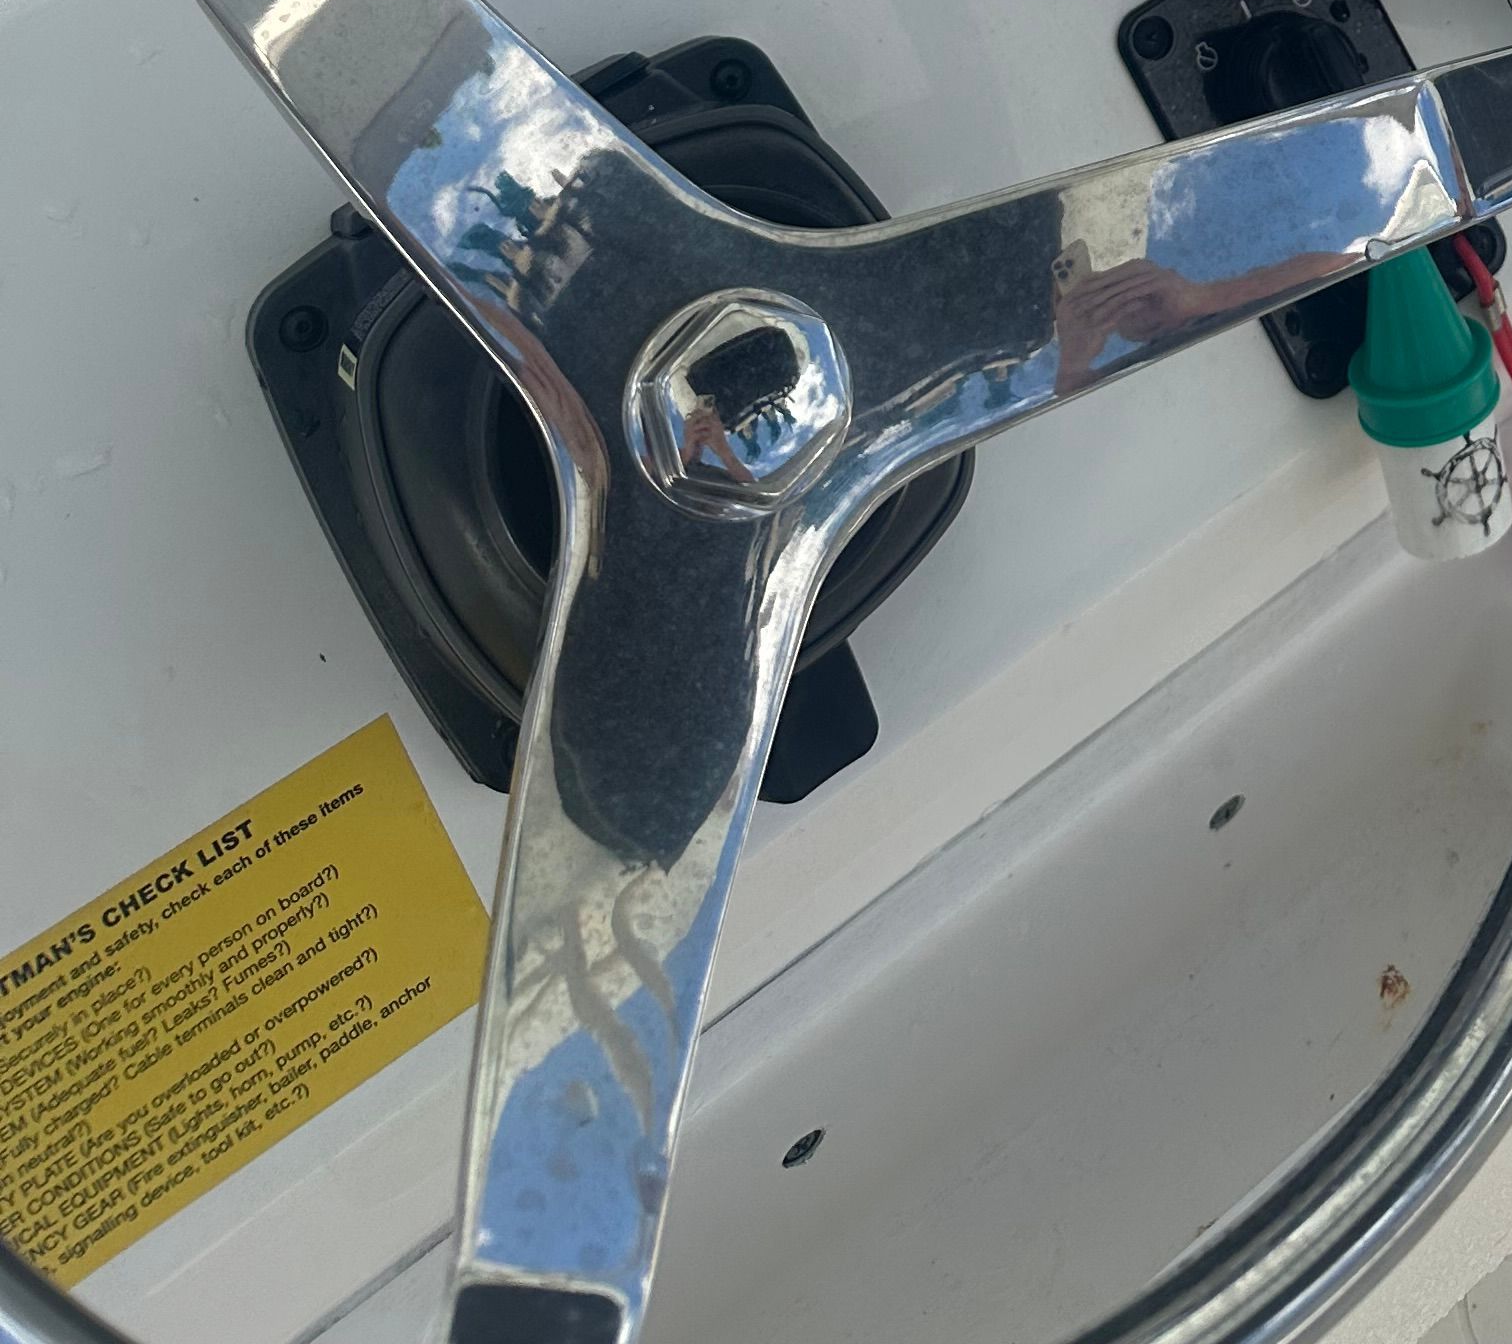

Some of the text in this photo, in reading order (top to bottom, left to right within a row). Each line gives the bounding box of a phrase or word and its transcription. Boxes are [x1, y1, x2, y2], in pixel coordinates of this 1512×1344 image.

[70, 951, 102, 980] and
[105, 919, 159, 956] safety,
[162, 883, 211, 919] check
[214, 856, 252, 885] each
[256, 839, 271, 858] of
[273, 814, 317, 845] these
[319, 784, 363, 817] items
[102, 860, 194, 927] CHECK
[197, 819, 252, 867] LIST
[0, 865, 338, 1096] DEVICES (One for every person on board?)
[11, 1004, 52, 1040] your
[57, 961, 121, 1008] engine:
[19, 1150, 78, 1197] PLATE
[80, 1129, 115, 1158] (Are
[116, 1104, 149, 1135] you
[152, 1039, 241, 1108] overloaded
[244, 1027, 259, 1045] or
[265, 947, 377, 1031] overpowered?)
[31, 1059, 117, 1123] (Adequate
[118, 1027, 157, 1062] fuel?
[161, 986, 218, 1033] Leaks?
[222, 940, 290, 992] Fumes?)
[44, 1075, 119, 1135] charged?
[123, 1044, 173, 1080] Cable
[175, 993, 248, 1046] terminals
[252, 963, 294, 995] clean
[297, 938, 326, 965] and
[328, 904, 377, 942] tight?)
[66, 1021, 139, 1076] (Working
[142, 970, 213, 1024] smoothly
[219, 945, 249, 973] and
[251, 892, 329, 954] properly?)
[70, 1010, 89, 1025] in
[91, 966, 151, 1016] place?)
[17, 1120, 91, 1177] neutral?)
[27, 1130, 142, 1215] CONDITIONS
[143, 1102, 187, 1138] (Safe
[188, 1088, 207, 1105] to
[210, 1072, 232, 1094] go
[235, 1039, 275, 1073] out?)
[58, 1135, 163, 1217] EQUIPMENT
[168, 1099, 229, 1144] (Lights,
[229, 1069, 273, 1100] horn,
[276, 1032, 326, 1071] pump,
[329, 995, 372, 1031] etc.?)
[58, 1083, 309, 1264] signalling device, tool kit, etc.?)
[73, 1189, 125, 1230] GEAR
[127, 1163, 164, 1195] (Fire
[167, 1092, 268, 1166] extinguisher,
[268, 1058, 317, 1095] bailer,
[319, 1019, 377, 1063] paddle,
[380, 976, 430, 1019] anchor
